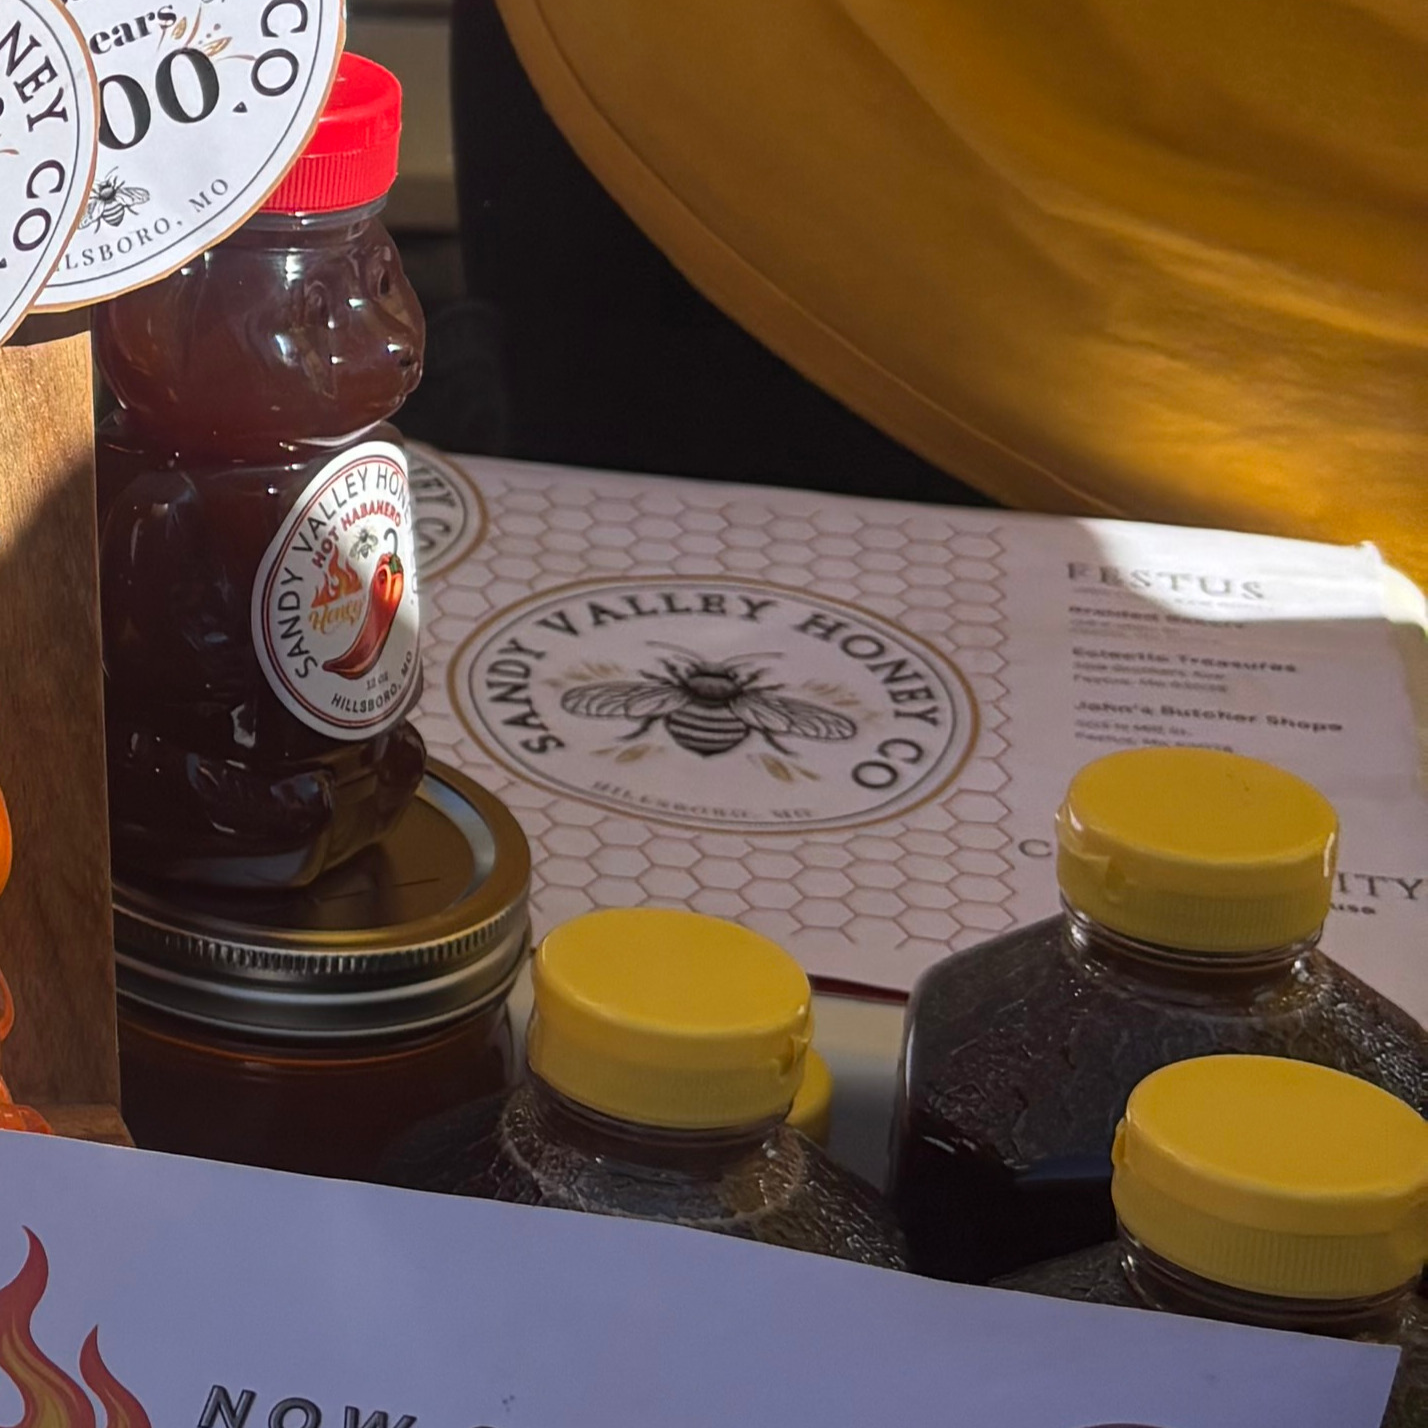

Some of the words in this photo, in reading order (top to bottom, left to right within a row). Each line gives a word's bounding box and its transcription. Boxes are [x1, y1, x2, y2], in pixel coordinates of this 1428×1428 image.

[91, 2, 178, 56] ears
[190, 177, 230, 215] MO
[292, 466, 369, 553] VALLEY
[312, 528, 340, 568] HOT
[339, 499, 402, 530] HABANERO
[1067, 561, 1265, 600] FESTUS
[278, 567, 318, 679] SANDY
[330, 679, 402, 713] HILLSBORO,
[400, 650, 413, 678] MO
[486, 635, 566, 757] SANDY
[536, 591, 780, 638] VALLEY
[792, 610, 942, 728] HONEY
